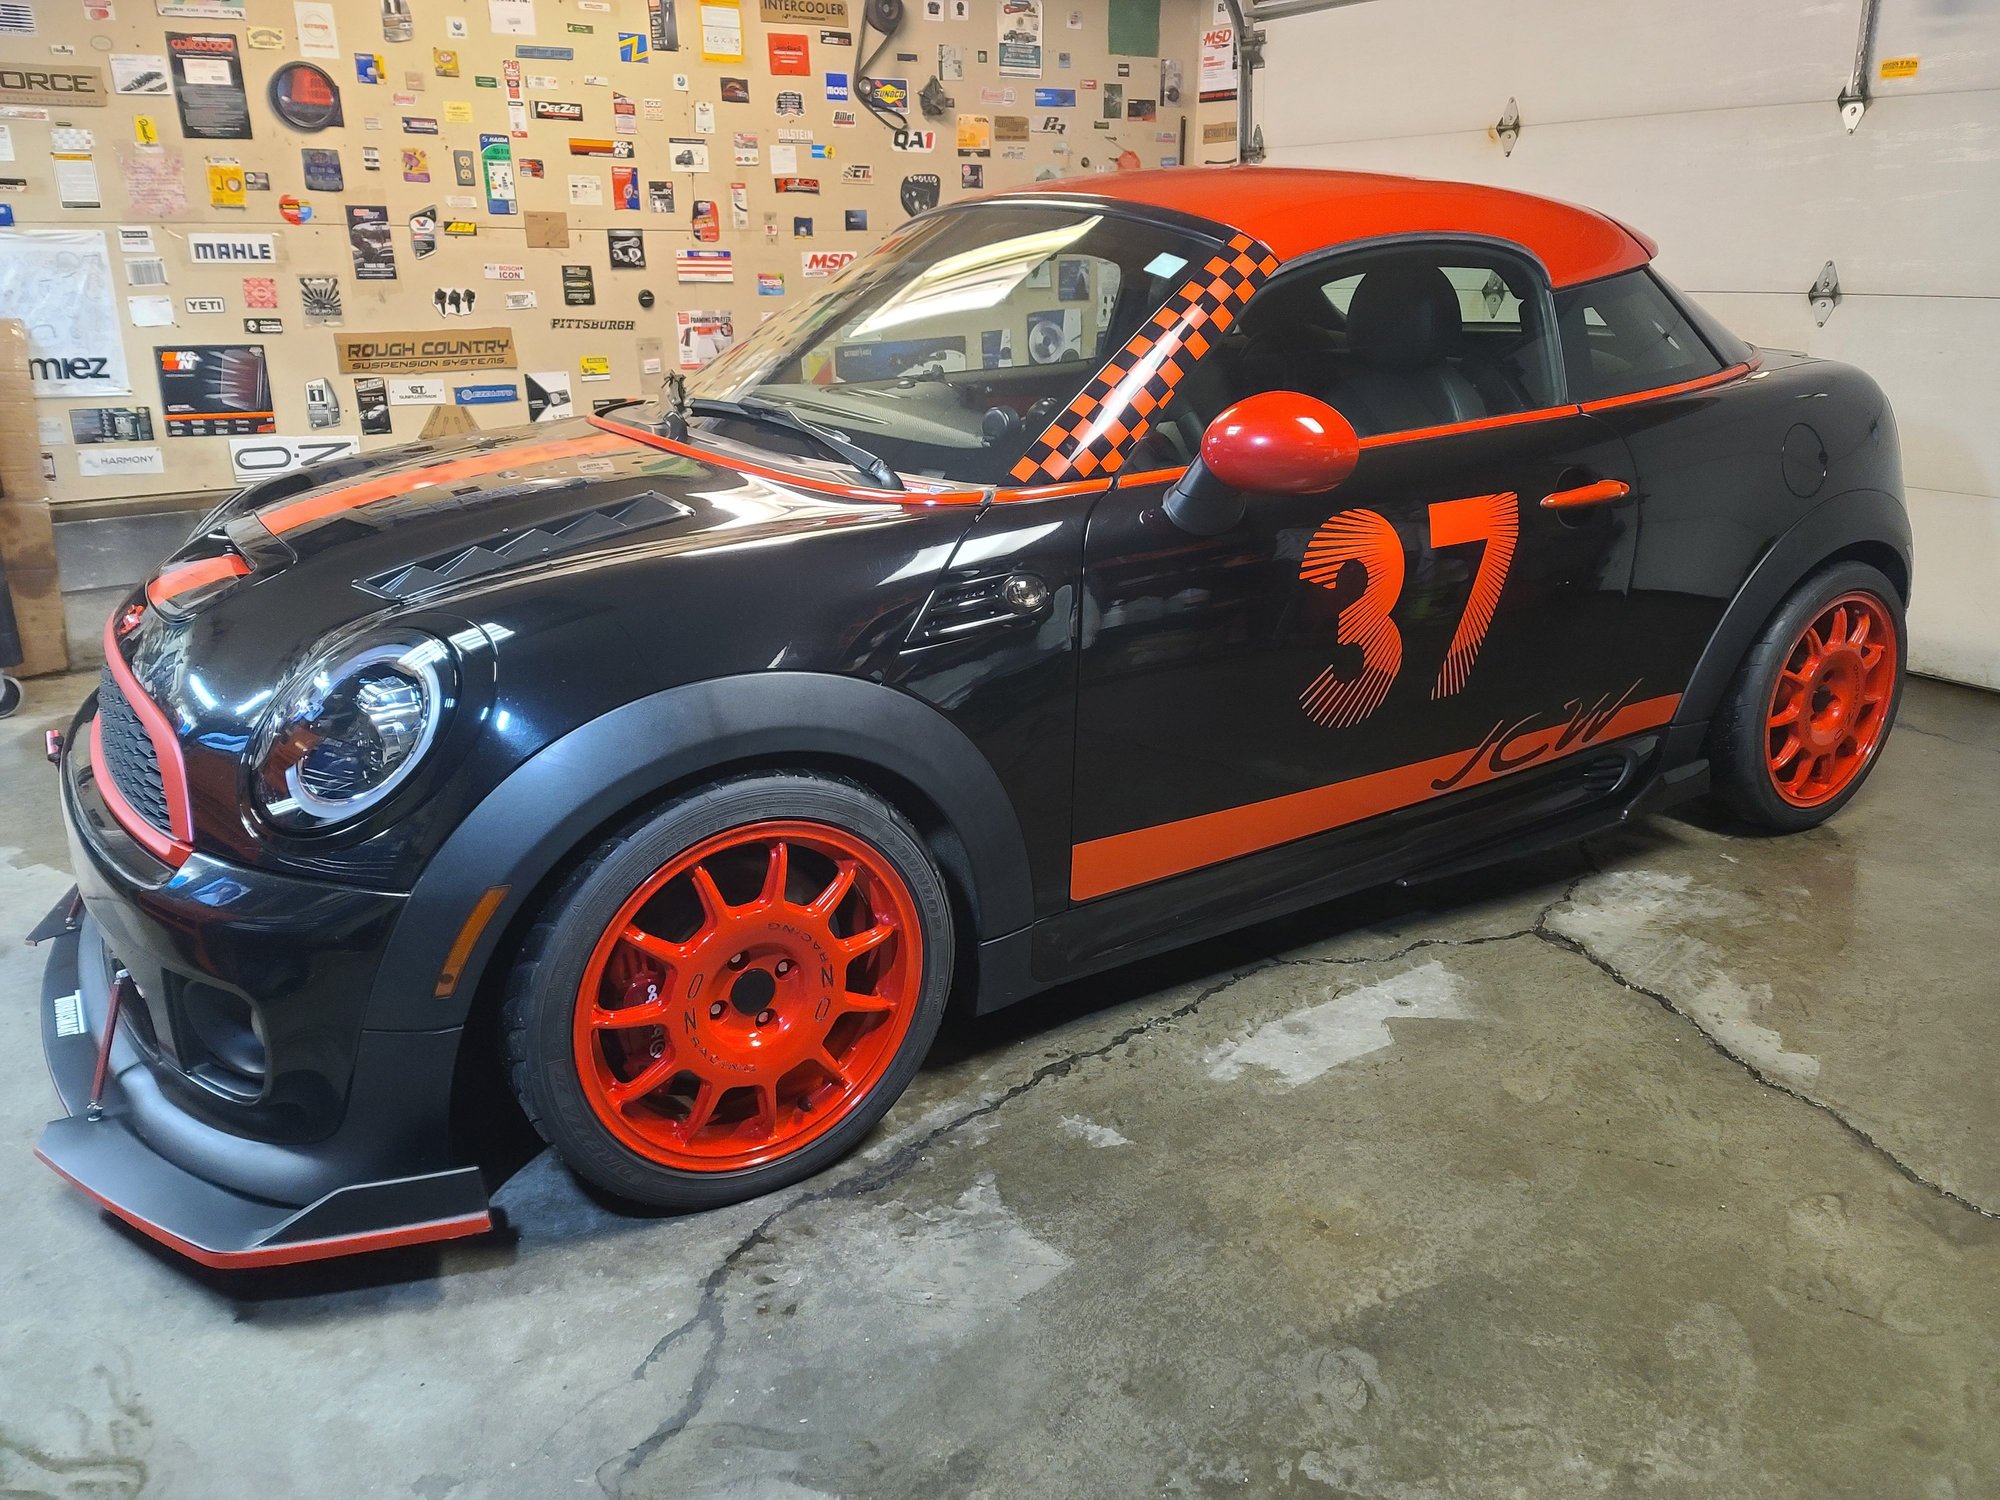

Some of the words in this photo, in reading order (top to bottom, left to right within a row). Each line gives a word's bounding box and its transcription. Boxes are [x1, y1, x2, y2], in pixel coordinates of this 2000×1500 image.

[1203, 29, 1232, 46] MSD
[826, 86, 847, 95] moss
[874, 90, 906, 98] SUNOCO
[834, 111, 855, 121] Billet
[778, 128, 814, 140] BILSTEIN
[893, 131, 934, 150] QA1
[194, 243, 271, 259] MAHLE
[808, 253, 854, 269] MSD
[189, 301, 221, 310] YETI
[551, 318, 636, 331] PITTSBURGH
[690, 316, 711, 324] FOAMING
[347, 343, 415, 358] ROUGH
[421, 339, 509, 356] COUNTRY
[351, 359, 438, 370] SUSPENSION
[101, 455, 154, 465] HARMONY
[1299, 491, 1519, 728] 37
[1430, 678, 1644, 791] JCW
